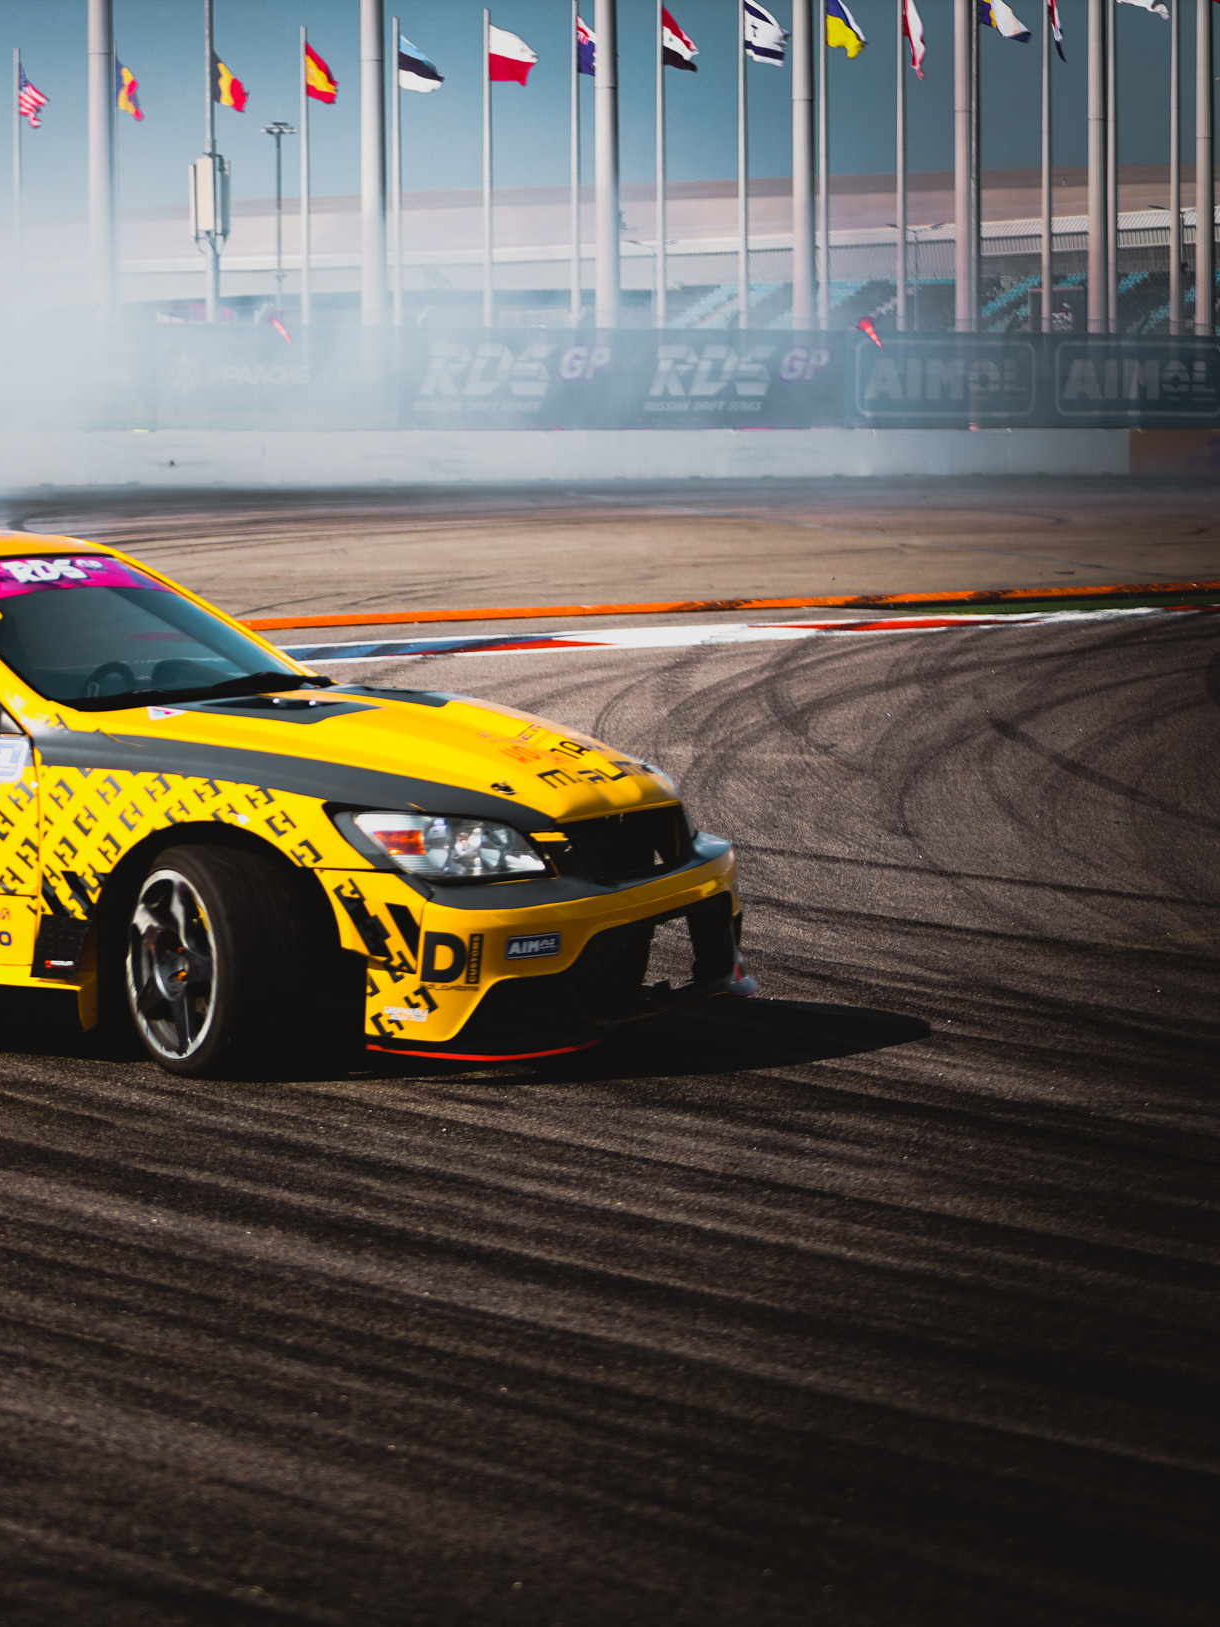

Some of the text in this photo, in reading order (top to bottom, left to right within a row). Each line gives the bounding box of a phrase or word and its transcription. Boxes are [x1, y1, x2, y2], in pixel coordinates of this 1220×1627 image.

[559, 344, 611, 381] GP
[649, 345, 830, 396] RDS GP
[864, 358, 1028, 400] AIMOL
[1061, 358, 1218, 400] AIMOL
[0, 558, 88, 583] RDS
[507, 938, 557, 955] AIMOL
